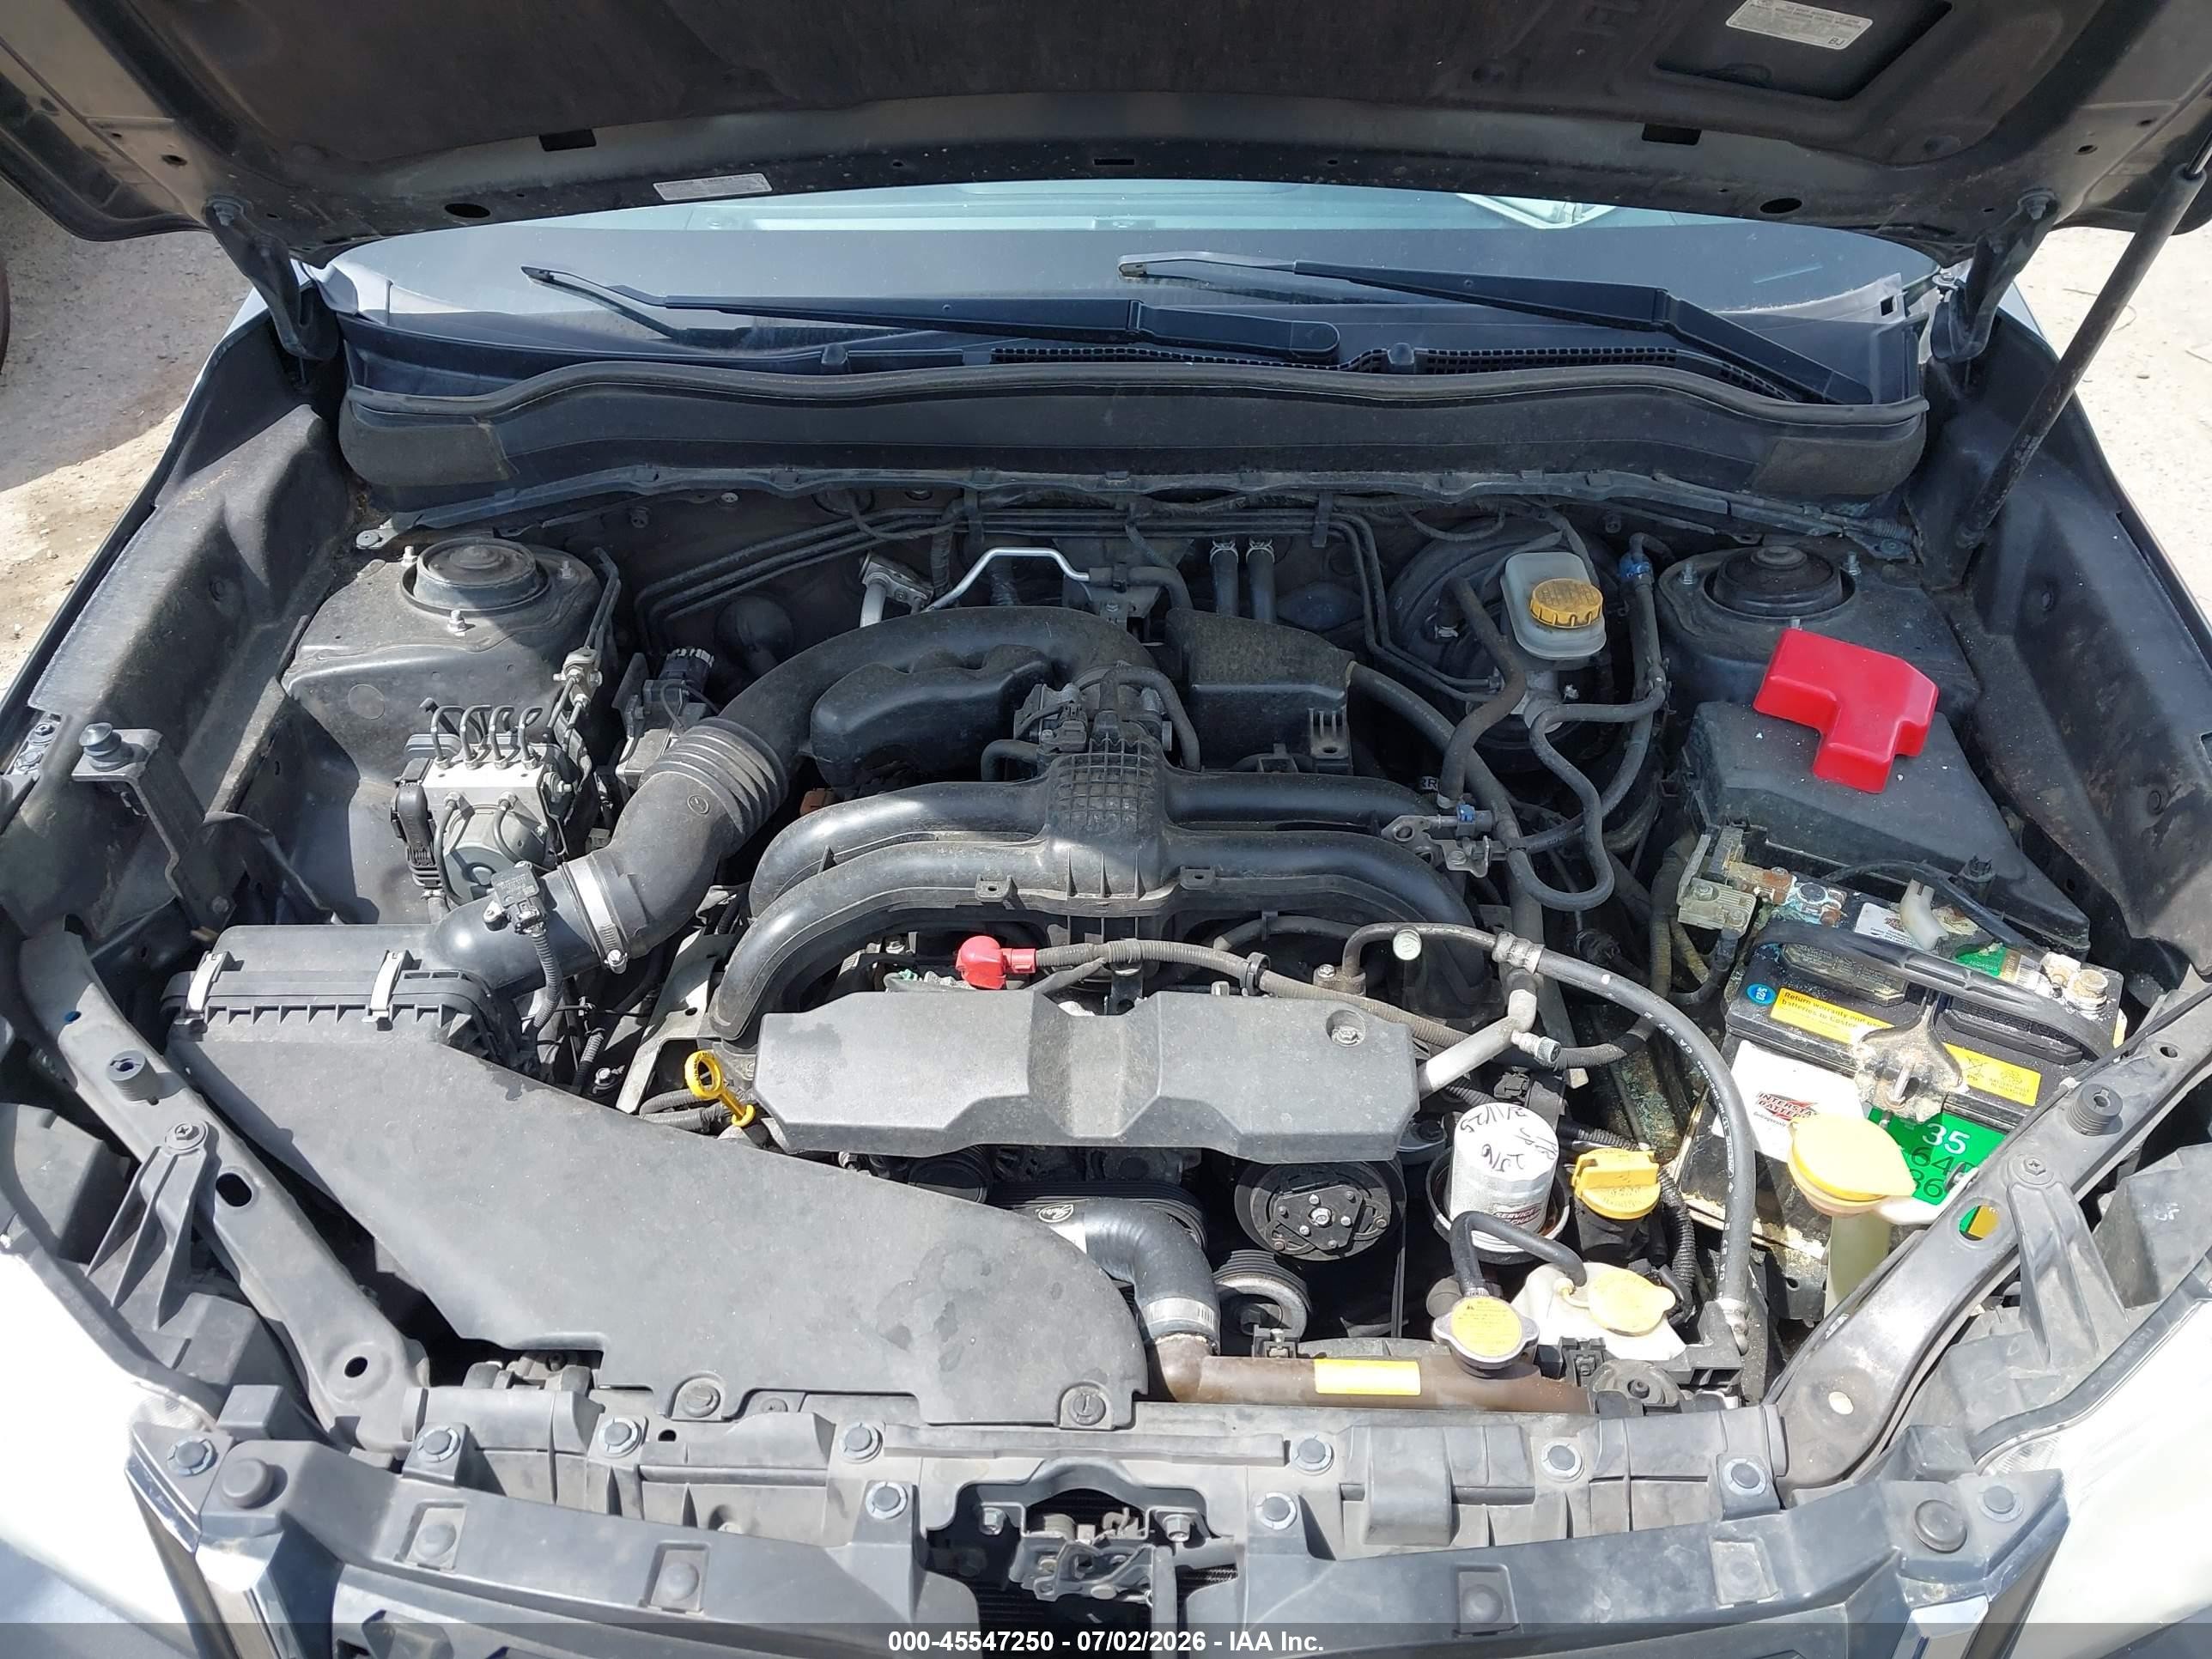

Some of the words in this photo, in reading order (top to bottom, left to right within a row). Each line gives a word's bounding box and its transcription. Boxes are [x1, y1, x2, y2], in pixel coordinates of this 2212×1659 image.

[1827, 38, 1845, 46] BJ
[1781, 998, 1817, 1015] batteries
[1784, 991, 1812, 1006] Return
[1812, 1002, 1847, 1018] warranty
[1850, 1014, 1866, 1024] and
[1758, 1093, 1817, 1117] INTERSTA
[1923, 1122, 1971, 1155] 35
